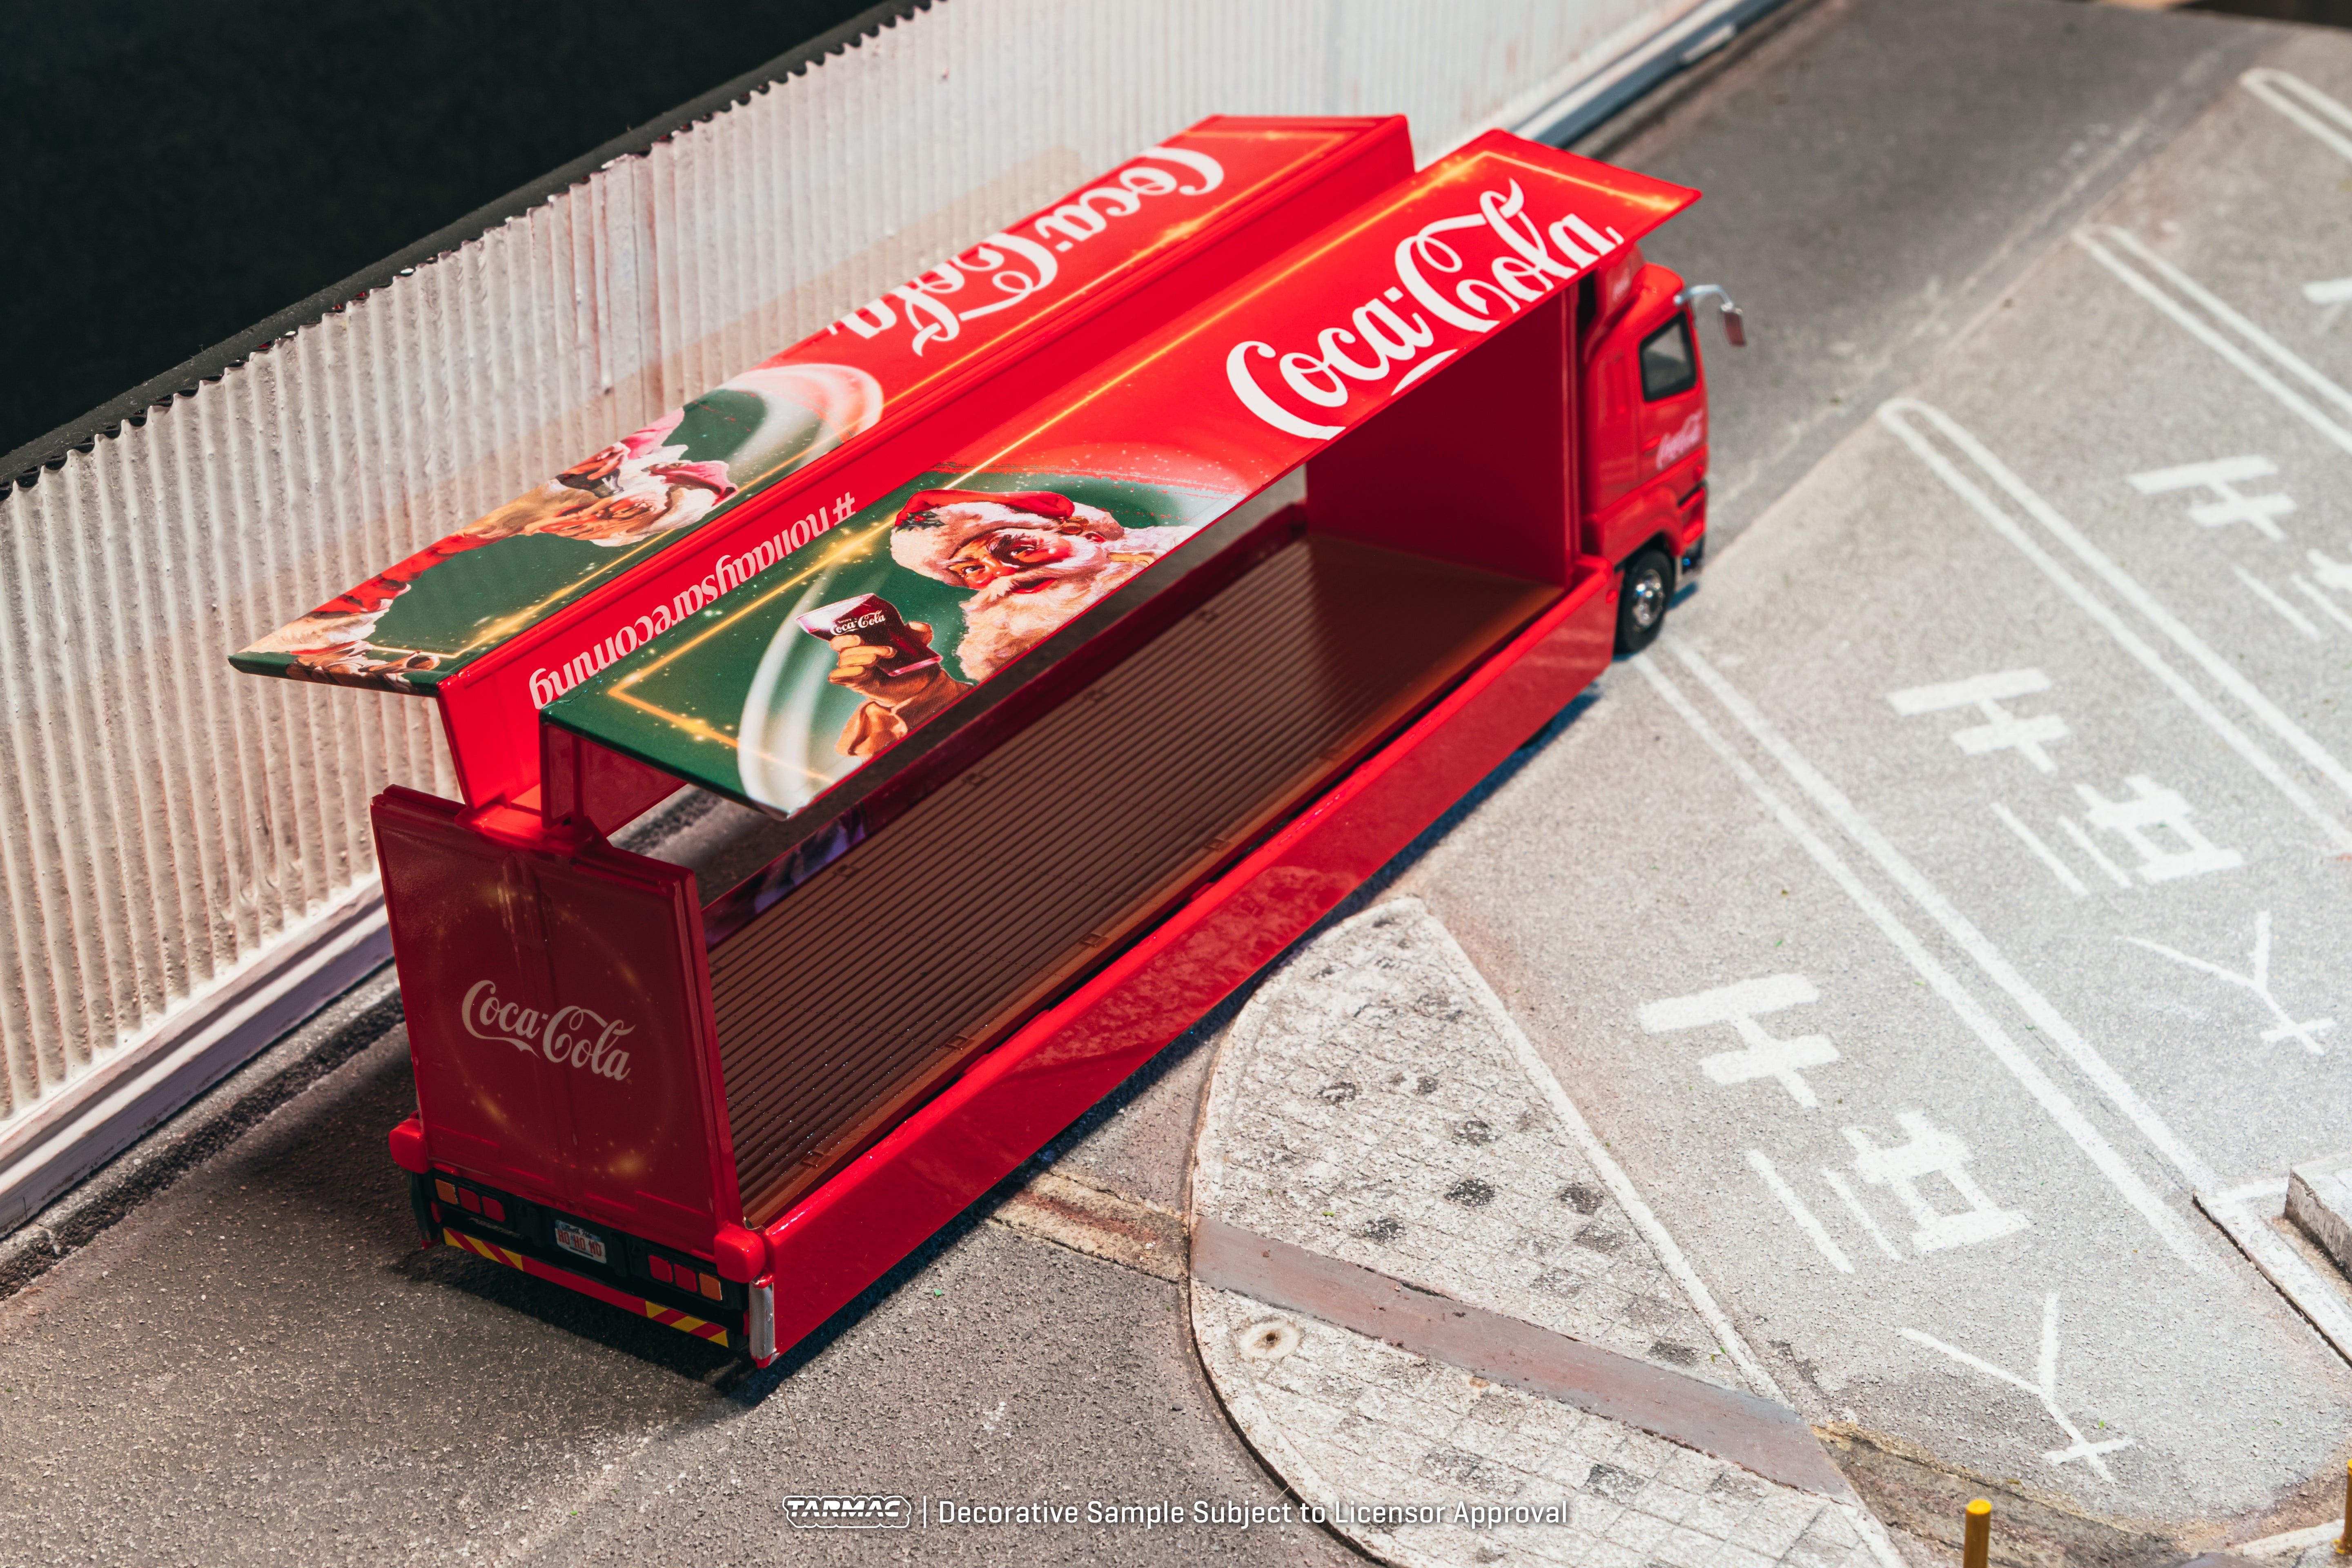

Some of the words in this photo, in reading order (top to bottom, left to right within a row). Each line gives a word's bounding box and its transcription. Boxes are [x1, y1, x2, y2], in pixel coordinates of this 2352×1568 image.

[1226, 177, 1624, 440] Coca-Cola
[830, 610, 886, 636] Coca-Cola
[461, 980, 636, 1081] Coca-Cola
[557, 1228, 570, 1245] HO
[573, 1234, 586, 1251] HO
[588, 1240, 602, 1257] HO
